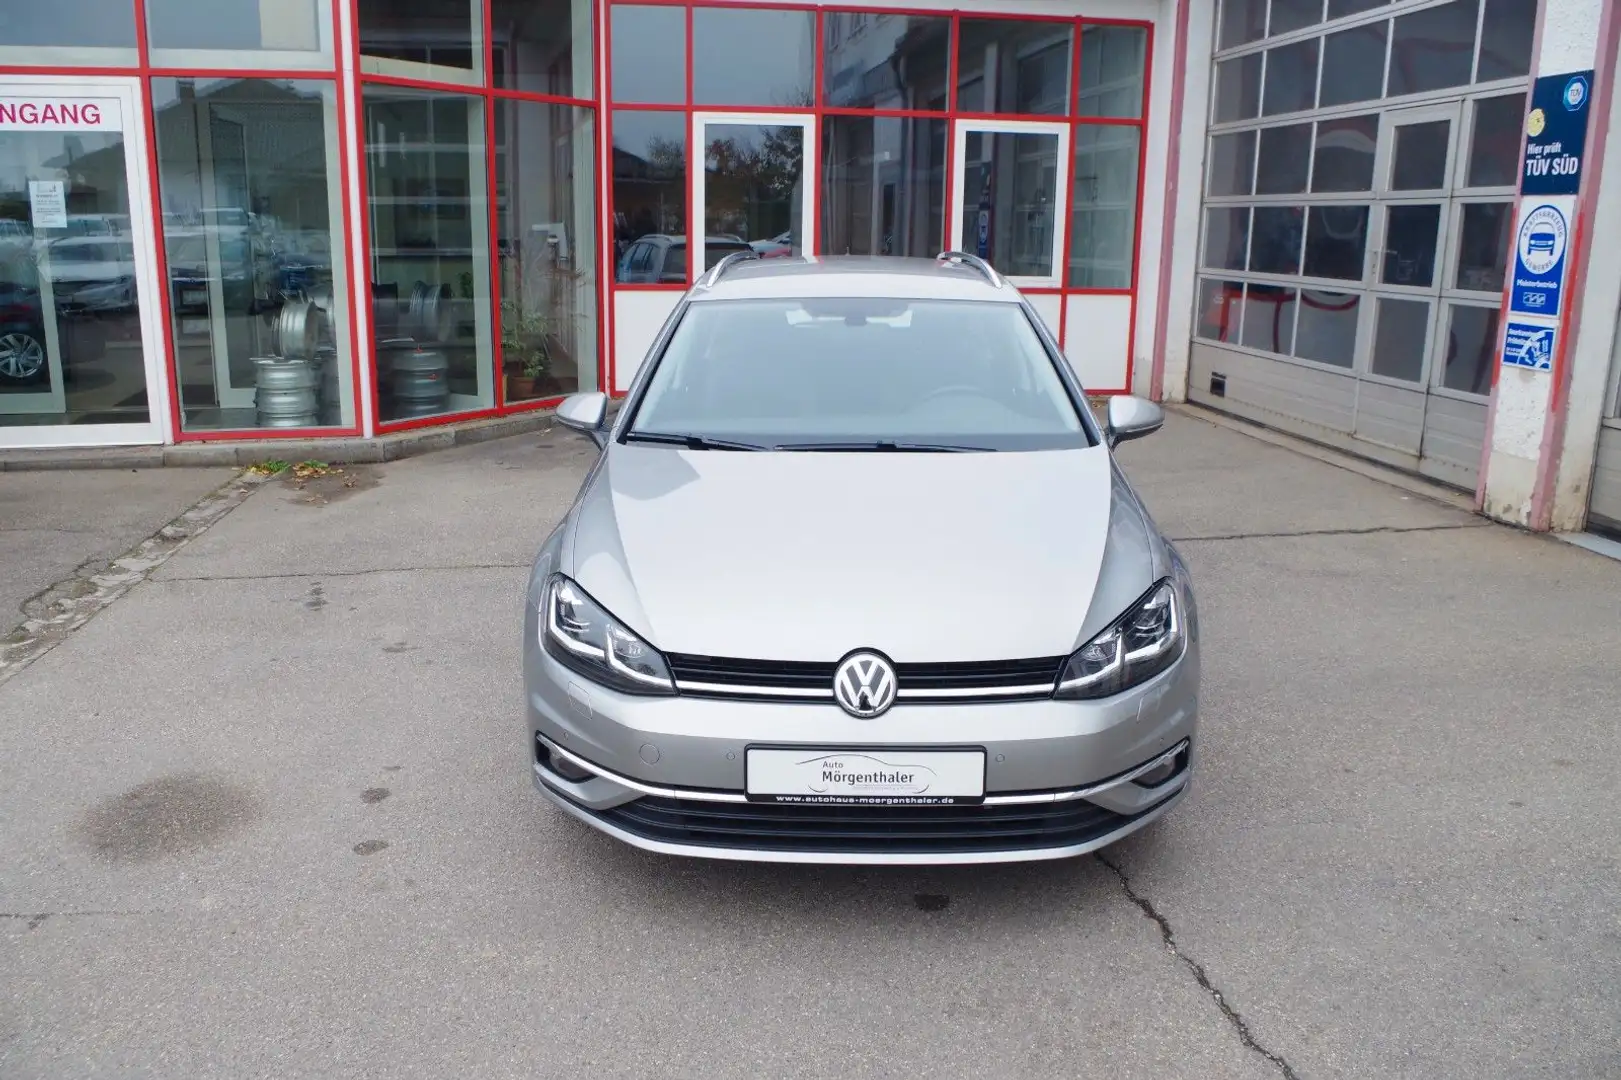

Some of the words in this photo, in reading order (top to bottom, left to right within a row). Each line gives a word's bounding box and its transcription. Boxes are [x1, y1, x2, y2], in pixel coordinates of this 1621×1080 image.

[0, 103, 101, 124] NGANG
[1527, 143, 1542, 155] Hier
[1543, 141, 1561, 156] prüft
[1526, 155, 1550, 176] TÜV
[1551, 153, 1578, 176] SÜD
[822, 760, 844, 769] Auto
[822, 770, 914, 785] Mörgenthaler
[776, 795, 954, 804] www.autohaus-moergenthaler.de
